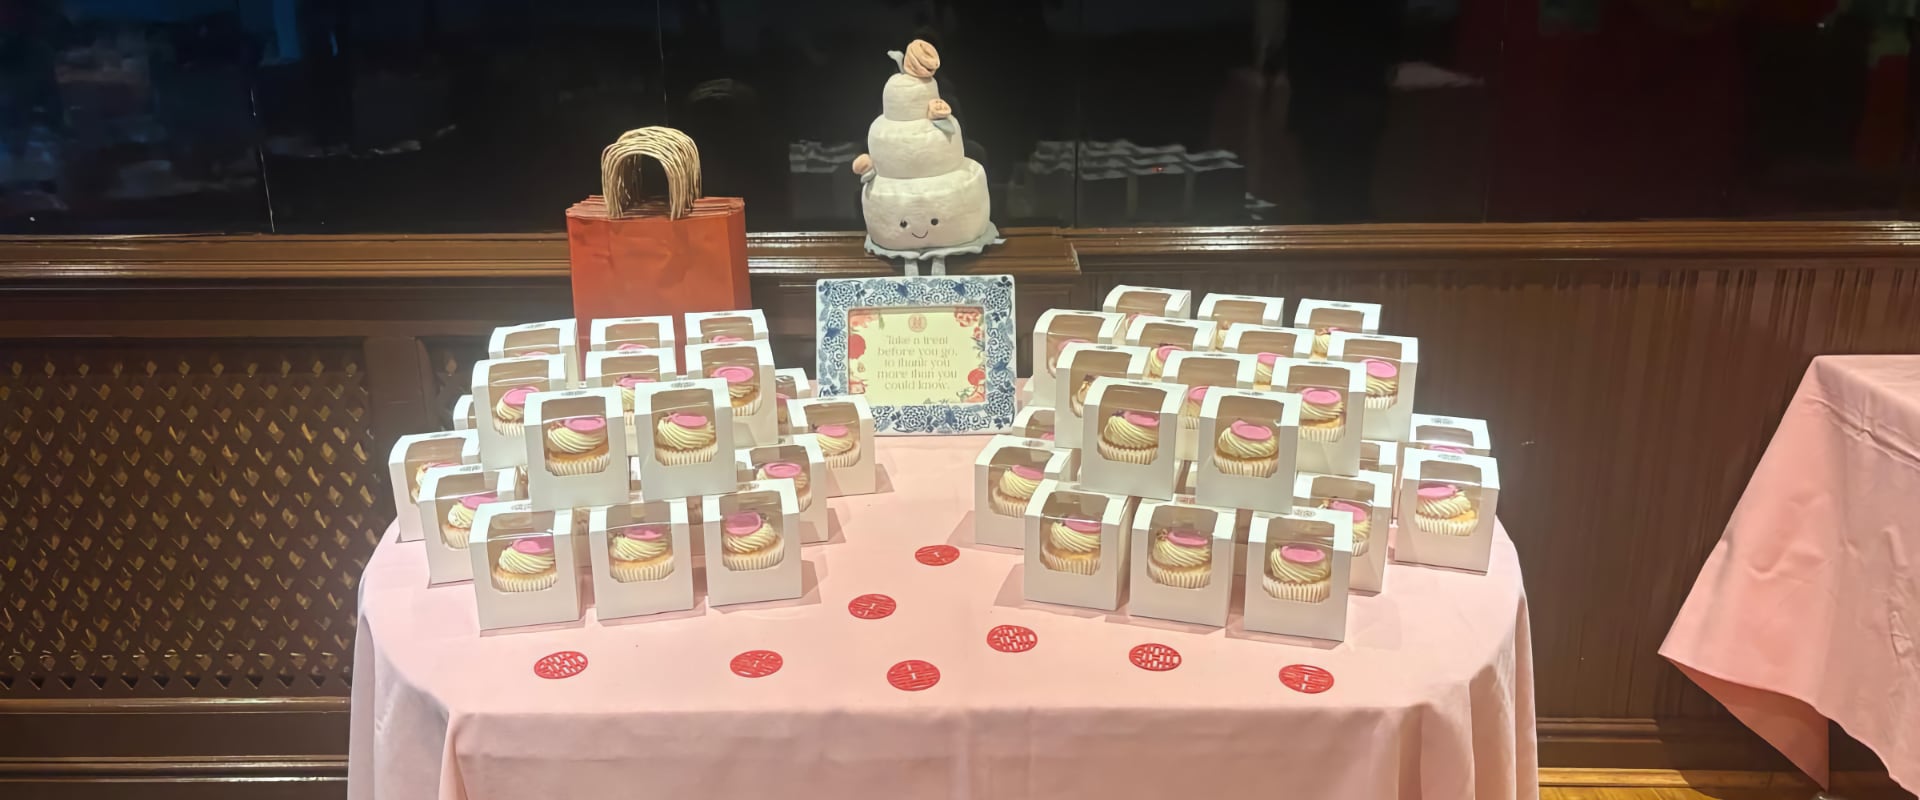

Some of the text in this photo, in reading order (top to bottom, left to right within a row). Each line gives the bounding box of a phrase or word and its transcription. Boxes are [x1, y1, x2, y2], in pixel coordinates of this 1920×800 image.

[886, 335, 911, 345] Take
[923, 335, 948, 345] treat
[878, 346, 916, 356] before
[918, 348, 938, 358] you
[884, 357, 950, 370] to thank you
[877, 368, 957, 381] more than you
[884, 380, 915, 391] could
